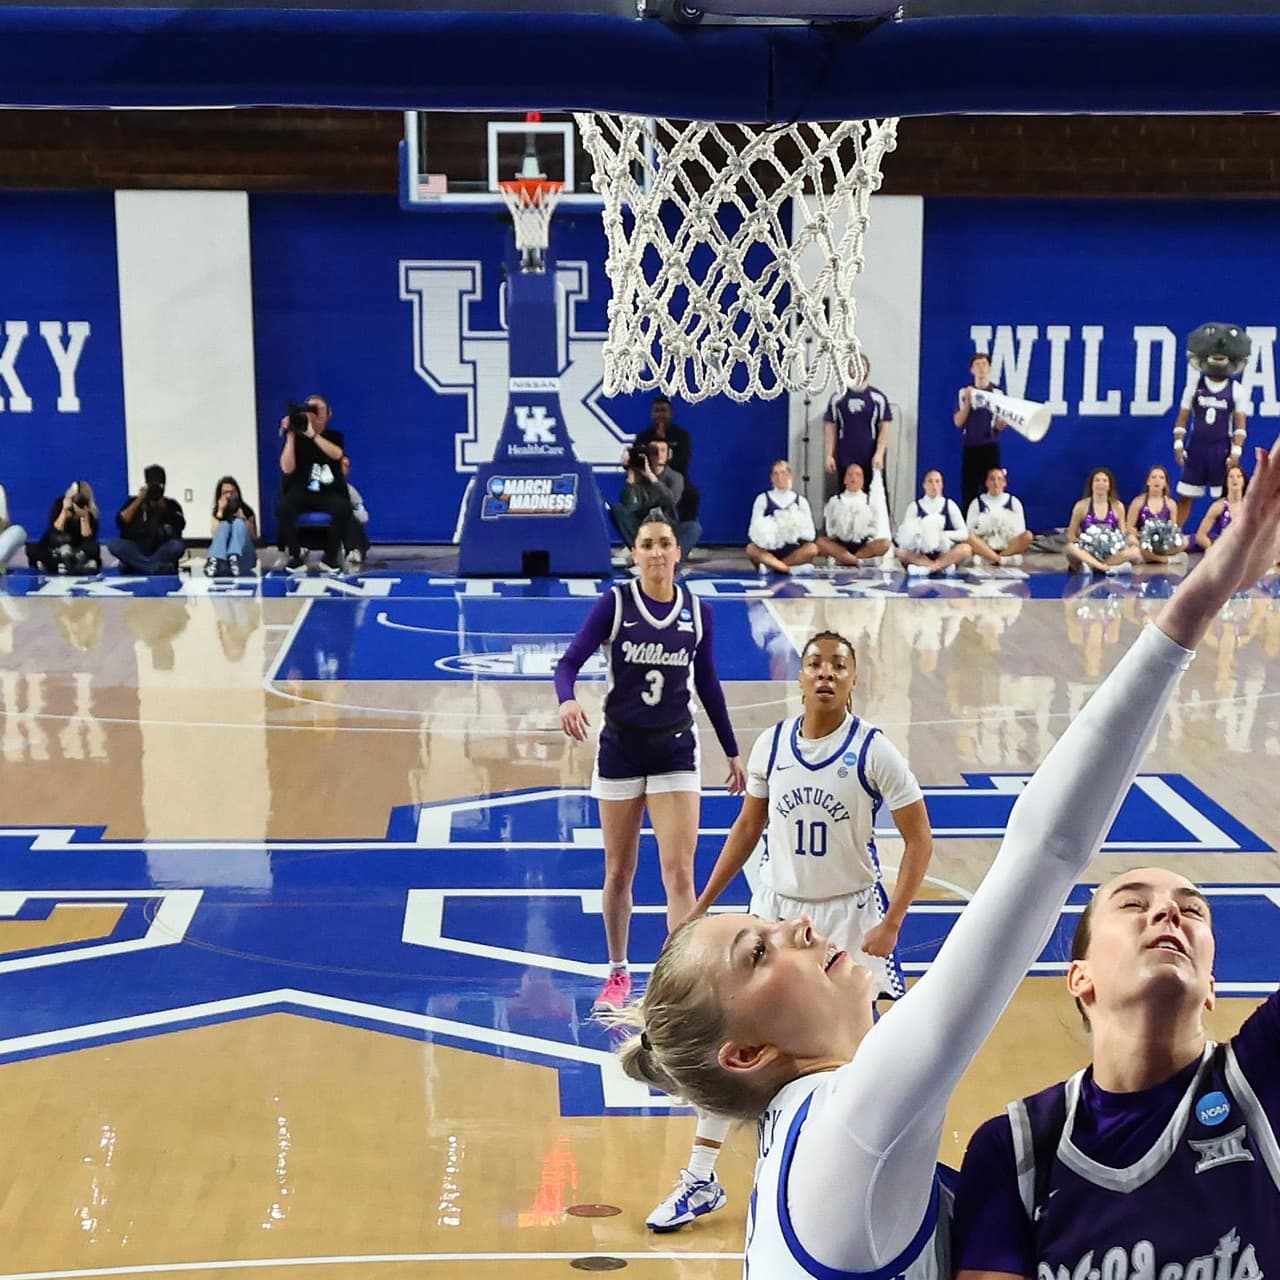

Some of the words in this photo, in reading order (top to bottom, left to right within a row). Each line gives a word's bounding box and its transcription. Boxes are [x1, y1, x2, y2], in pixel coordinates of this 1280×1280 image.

[513, 379, 556, 389] NISSAN
[514, 406, 556, 443] UK
[508, 443, 564, 455] HealthCare
[504, 479, 552, 494] MARCH
[508, 494, 575, 510] MADNESS
[621, 640, 692, 668] Wildcats
[641, 669, 664, 705] 3
[776, 786, 851, 824] KENTUCKY
[794, 819, 828, 857] 10
[1200, 1103, 1230, 1121] NCAA
